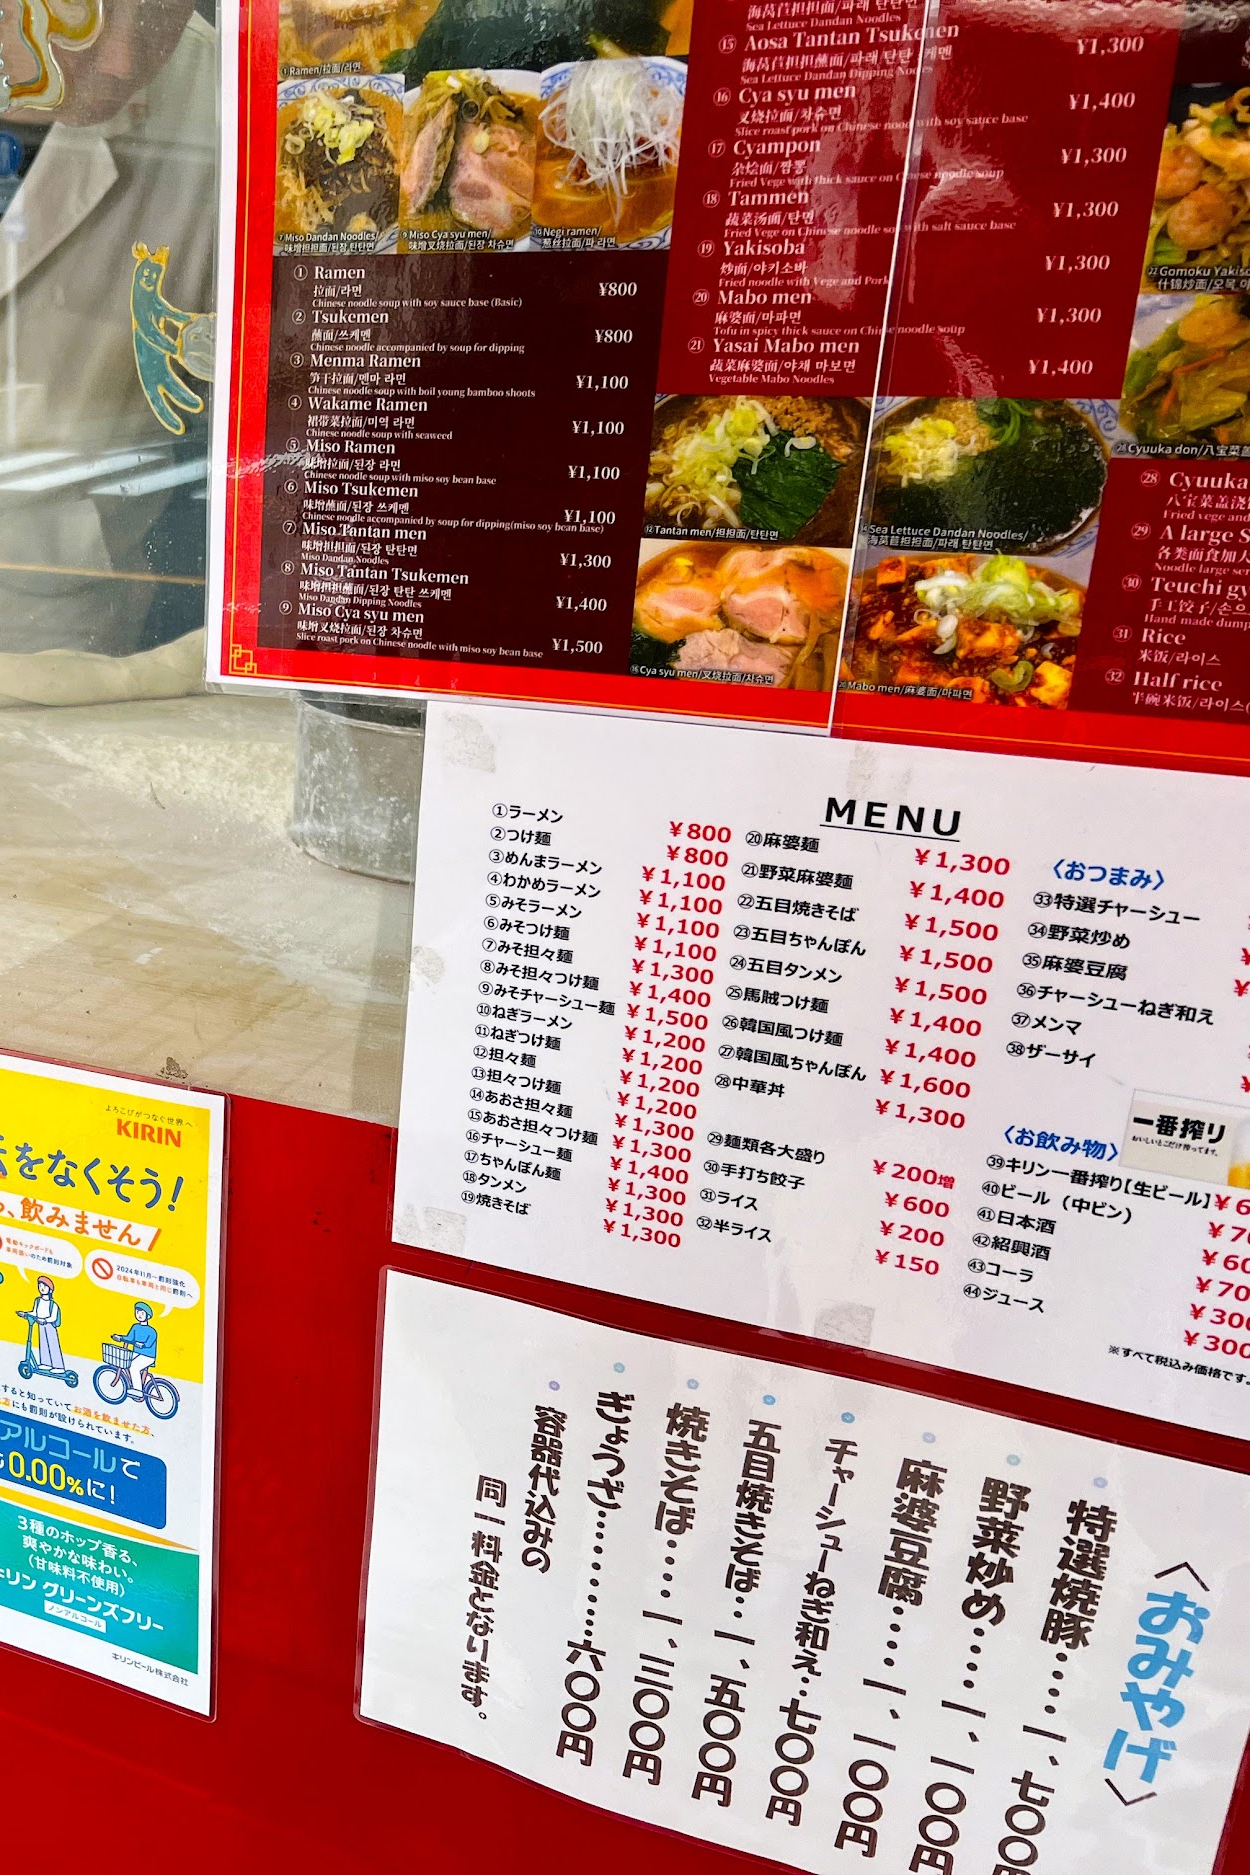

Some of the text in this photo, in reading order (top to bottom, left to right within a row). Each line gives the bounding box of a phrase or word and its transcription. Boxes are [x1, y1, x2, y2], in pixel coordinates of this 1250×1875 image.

[745, 35, 788, 52] Aosa
[793, 29, 860, 49] Tantan
[1076, 36, 1144, 56] ¥1,300
[1069, 92, 1136, 111] ¥1,400
[733, 140, 821, 160] Cyampon
[728, 191, 809, 207] Tammen
[285, 233, 304, 241] Miso
[306, 232, 339, 242] Dandan
[723, 239, 805, 256] Yakisoba
[314, 265, 365, 280] Ramen
[1160, 266, 1210, 276] Gomoku
[598, 282, 638, 297] ¥800
[717, 289, 811, 305] Mabo men
[312, 297, 522, 310] Chinese noodle soup with soy sauce base (Basic)
[312, 310, 389, 325] Tsukemen
[1036, 308, 1102, 325] ¥1,300
[595, 329, 633, 344] ¥800
[713, 338, 860, 354] Yasai Mabo men
[310, 354, 421, 369] Menma Ramen
[1028, 359, 1093, 376] ¥1,400
[575, 375, 629, 391] ¥1,100
[709, 374, 834, 385] Vegetable Mabo Noodles
[308, 397, 428, 412] Wakame Ramen
[306, 440, 396, 455] Miso Ramen
[1169, 472, 1249, 490] Cyuuka
[302, 522, 427, 541] Miso Tantan men
[654, 525, 687, 538] Tantan
[869, 524, 889, 536] Sea
[891, 525, 930, 538] Lettuce
[932, 526, 976, 540] Dandan
[1159, 524, 1234, 546] A large
[560, 553, 612, 570] ¥1,300
[1150, 577, 1222, 596] Teuchi
[298, 603, 424, 625] Miso Cya syu men
[1142, 629, 1186, 646] Rice
[552, 639, 603, 655] ¥1,500
[847, 681, 875, 693] Mabo
[1133, 672, 1222, 692] Half rice
[825, 797, 960, 836] MENU
[116, 1118, 182, 1148] KIRIN
[521, 1404, 567, 1574] 容器代込みの
[462, 1475, 507, 1720] 同一料金となります。
